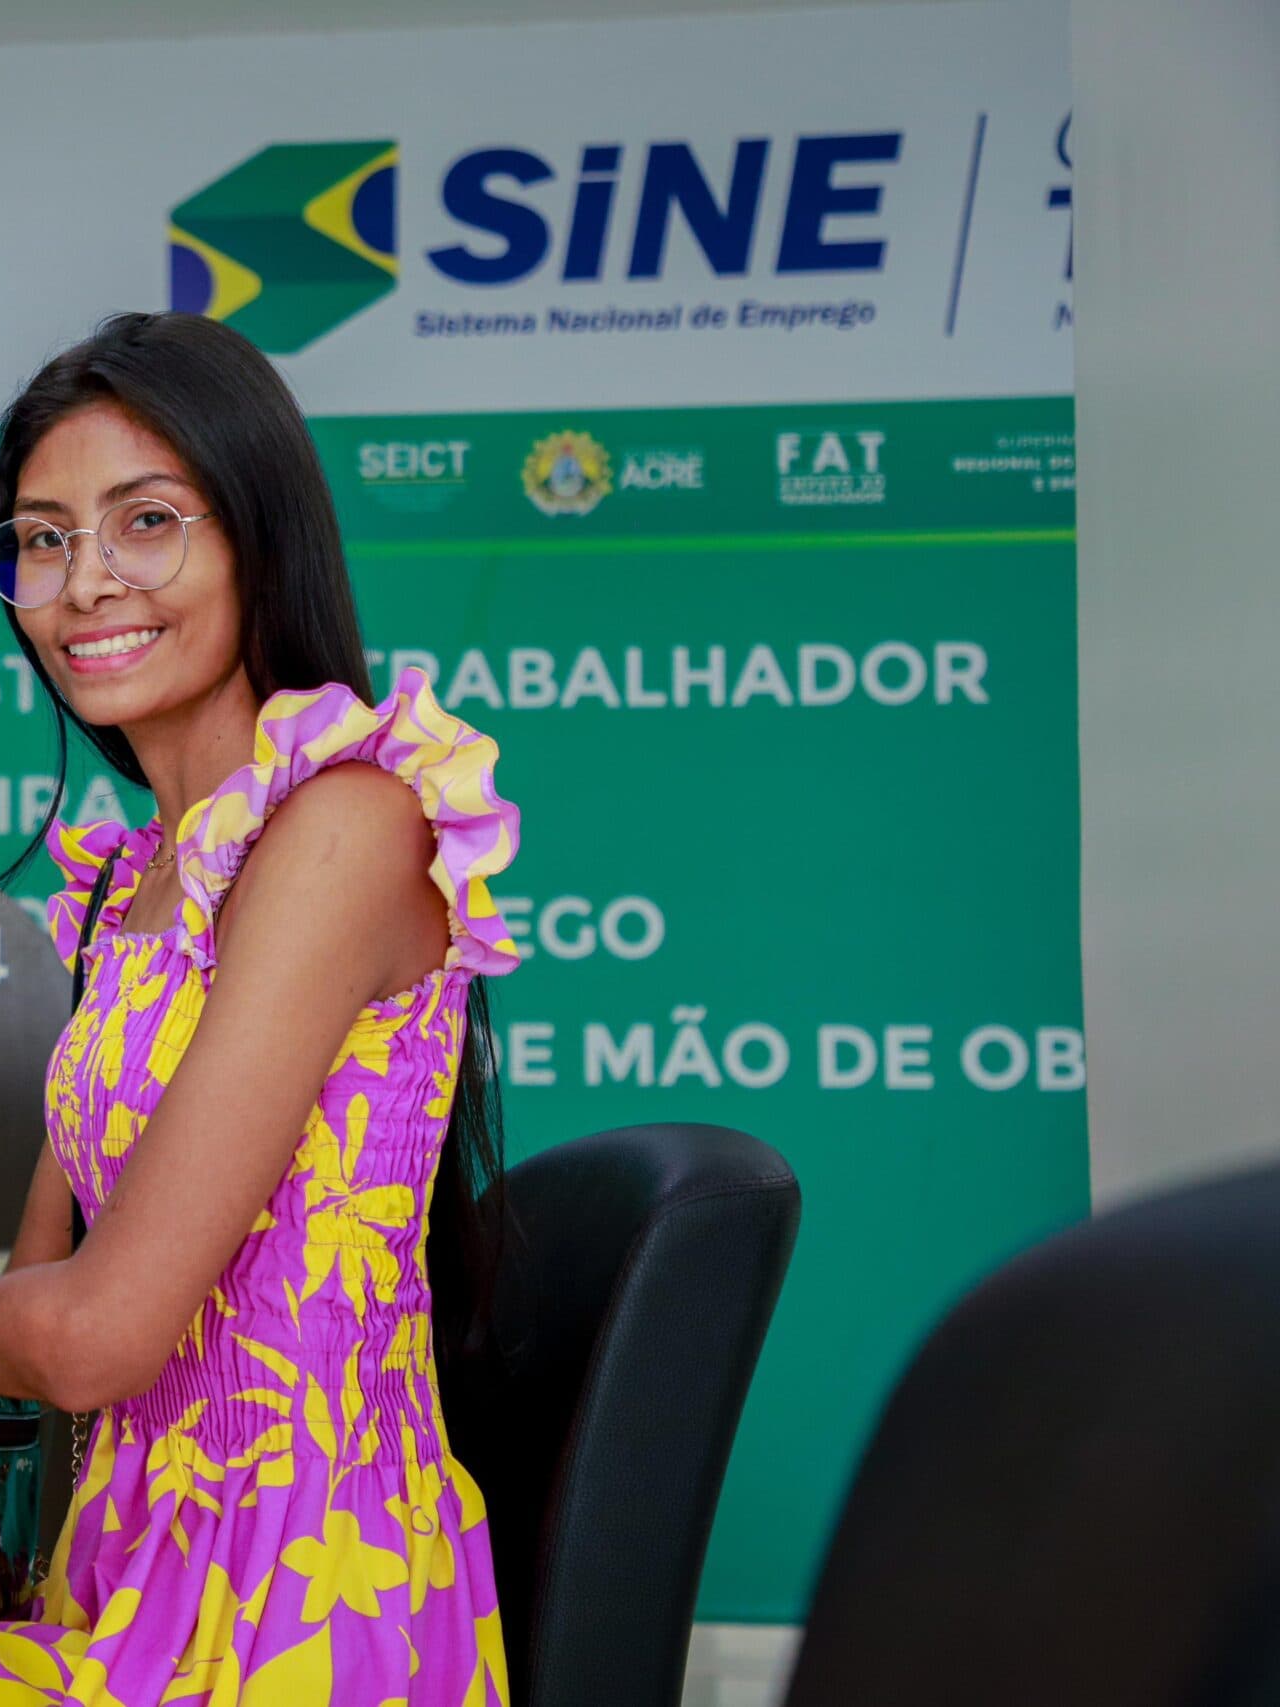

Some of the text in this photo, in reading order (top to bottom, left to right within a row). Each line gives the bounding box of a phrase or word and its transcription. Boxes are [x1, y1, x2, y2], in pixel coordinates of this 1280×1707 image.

[415, 299, 877, 338] Sistema Nacional de Emprego
[360, 441, 469, 478] SEICT
[777, 430, 885, 474] FAT
[583, 1005, 790, 1088] MÃO
[817, 1024, 935, 1090] DE
[959, 1024, 1088, 1092] OB
